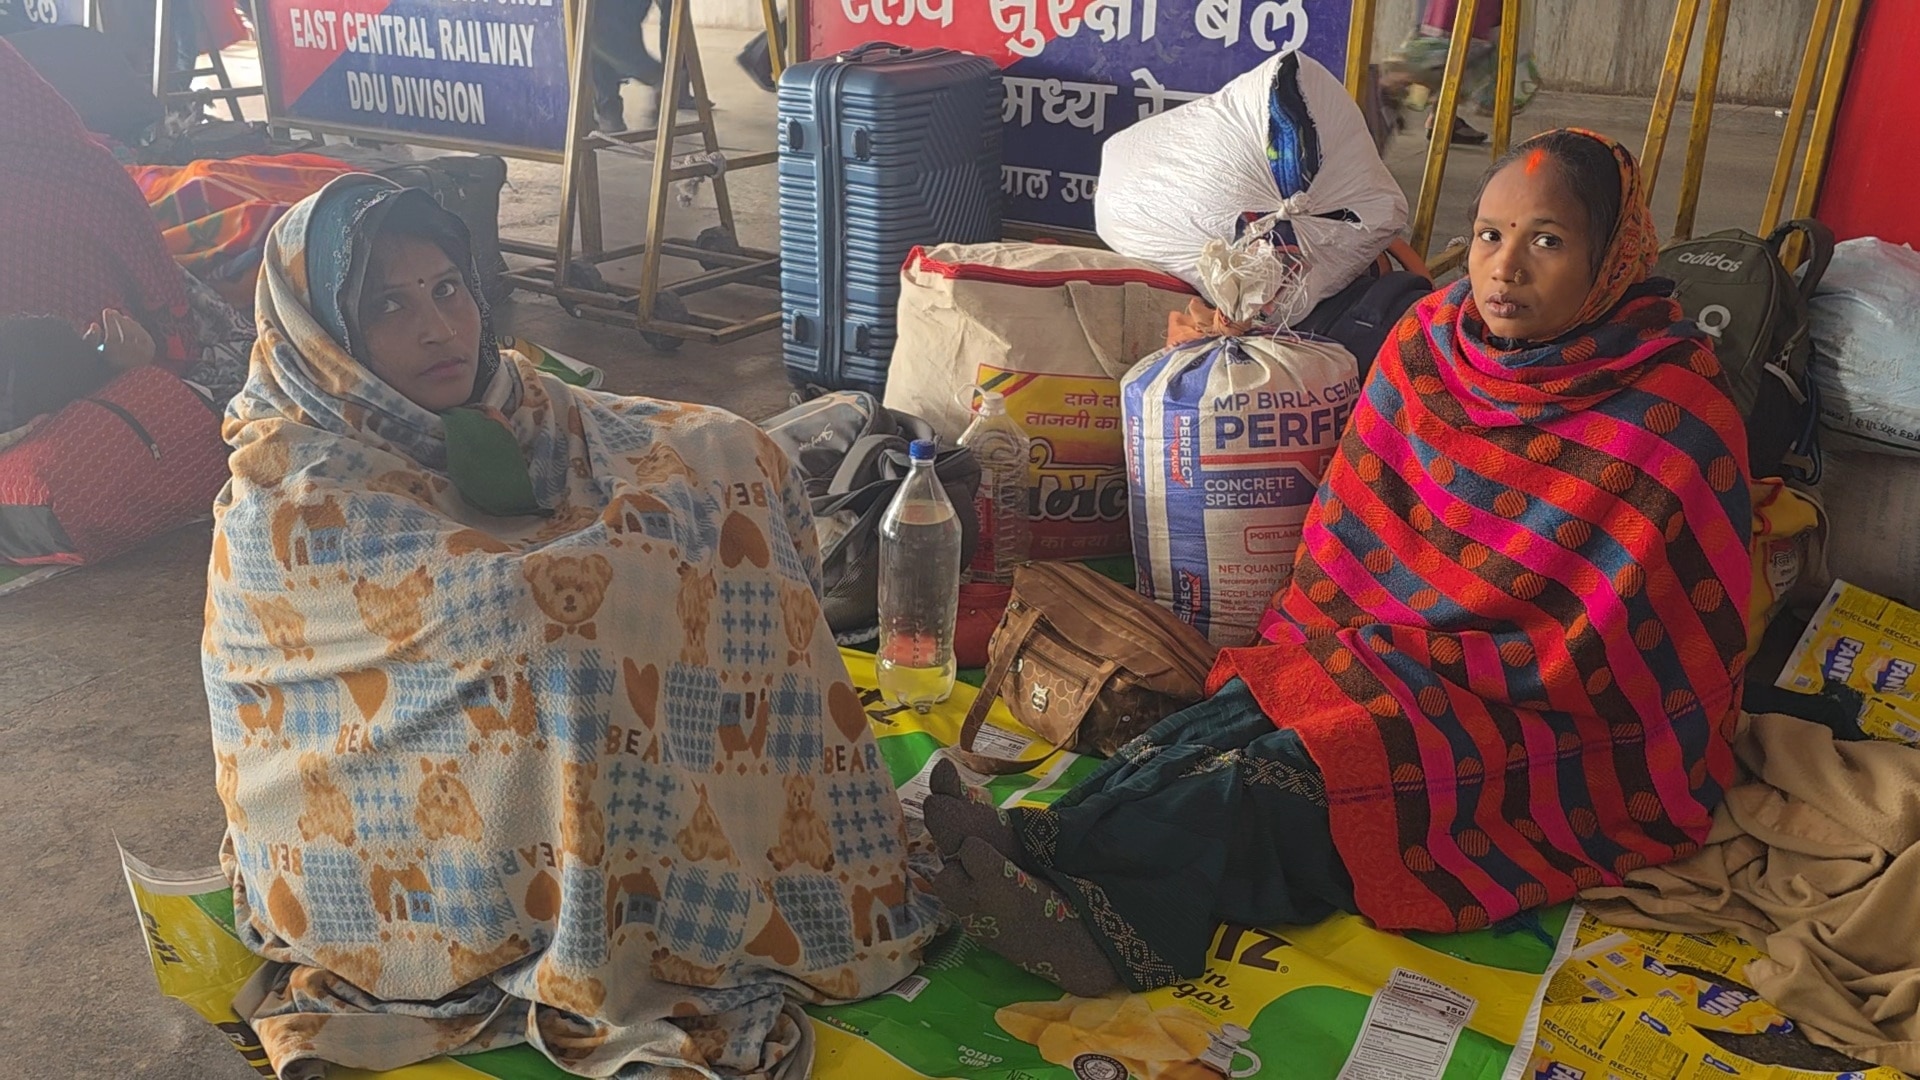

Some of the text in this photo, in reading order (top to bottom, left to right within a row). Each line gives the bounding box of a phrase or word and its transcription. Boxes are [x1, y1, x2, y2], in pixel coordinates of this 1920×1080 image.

[290, 8, 536, 68] EAST CENTRAL RAILWAY
[1194, 0, 1309, 51] बल
[346, 71, 486, 125] DDU DIVISION
[1001, 76, 1118, 135] मध्य
[1678, 251, 1743, 273] adidas
[1064, 388, 1099, 406] दाने
[1215, 375, 1359, 412] MP BIRLA CEM
[1026, 409, 1091, 429] ताजगी
[1215, 401, 1355, 450] PERFE
[1131, 415, 1142, 486] PERFECT
[1171, 448, 1180, 474] PLUS
[1180, 415, 1194, 488] PERFECT
[1204, 476, 1295, 492] CONCRETE
[1218, 563, 1293, 575] NET QUANTI
[1828, 636, 1864, 684] FANT
[823, 742, 879, 775] BEAR
[1171, 983, 1235, 1011] gar
[1398, 970, 1442, 989] Nutrition
[1445, 986, 1472, 1003] Facts
[1445, 1005, 1465, 1017] 150
[957, 1045, 1004, 1064] POTATO
[1542, 1018, 1606, 1063] RECÍCLAME
[958, 1055, 991, 1069] CHIPS
